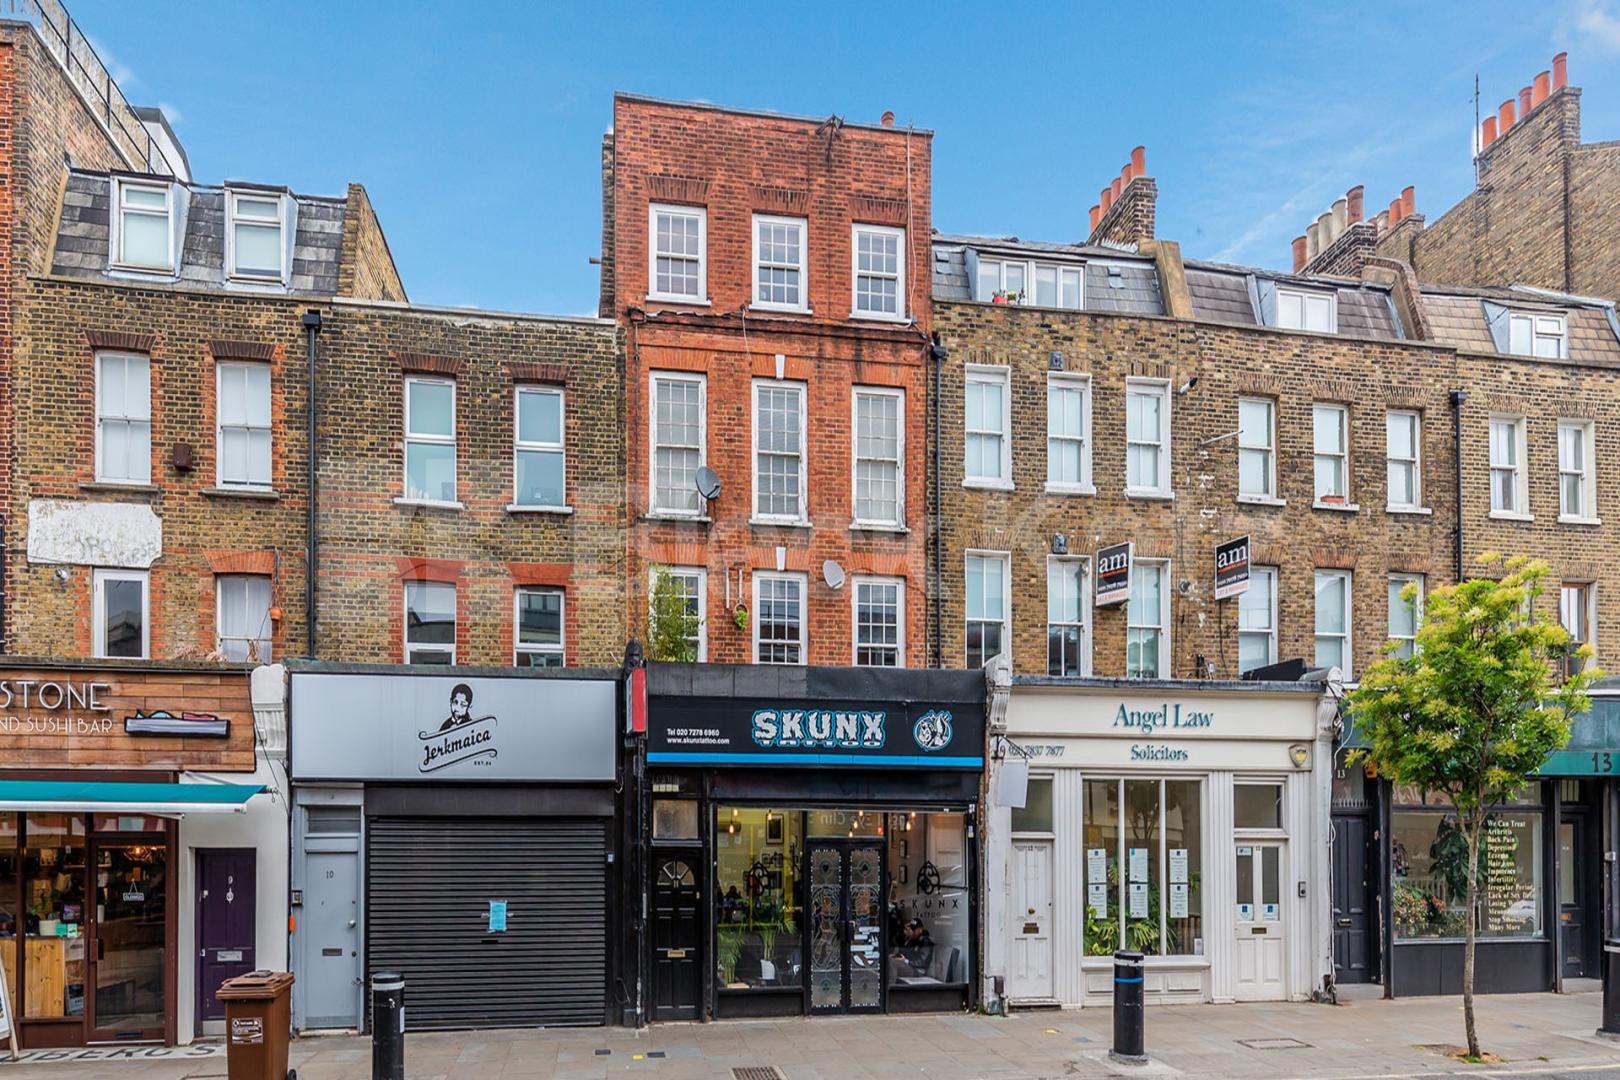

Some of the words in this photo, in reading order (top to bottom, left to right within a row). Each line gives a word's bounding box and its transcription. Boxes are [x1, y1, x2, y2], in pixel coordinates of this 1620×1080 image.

[1099, 552, 1128, 574] am
[1218, 545, 1248, 568] am
[0, 681, 110, 710] STONE
[24, 716, 72, 732] SUSHI
[77, 717, 113, 733] BAR
[754, 711, 884, 741] SKUNX
[1112, 702, 1168, 733] Angel
[1173, 704, 1214, 727] Law
[667, 728, 675, 736] Tel
[676, 728, 688, 736] 020
[422, 729, 492, 766] Jerkmaica
[1131, 744, 1189, 761] Solicitors
[1592, 751, 1613, 773] 13
[1337, 769, 1346, 778] 13
[325, 870, 335, 879] 10
